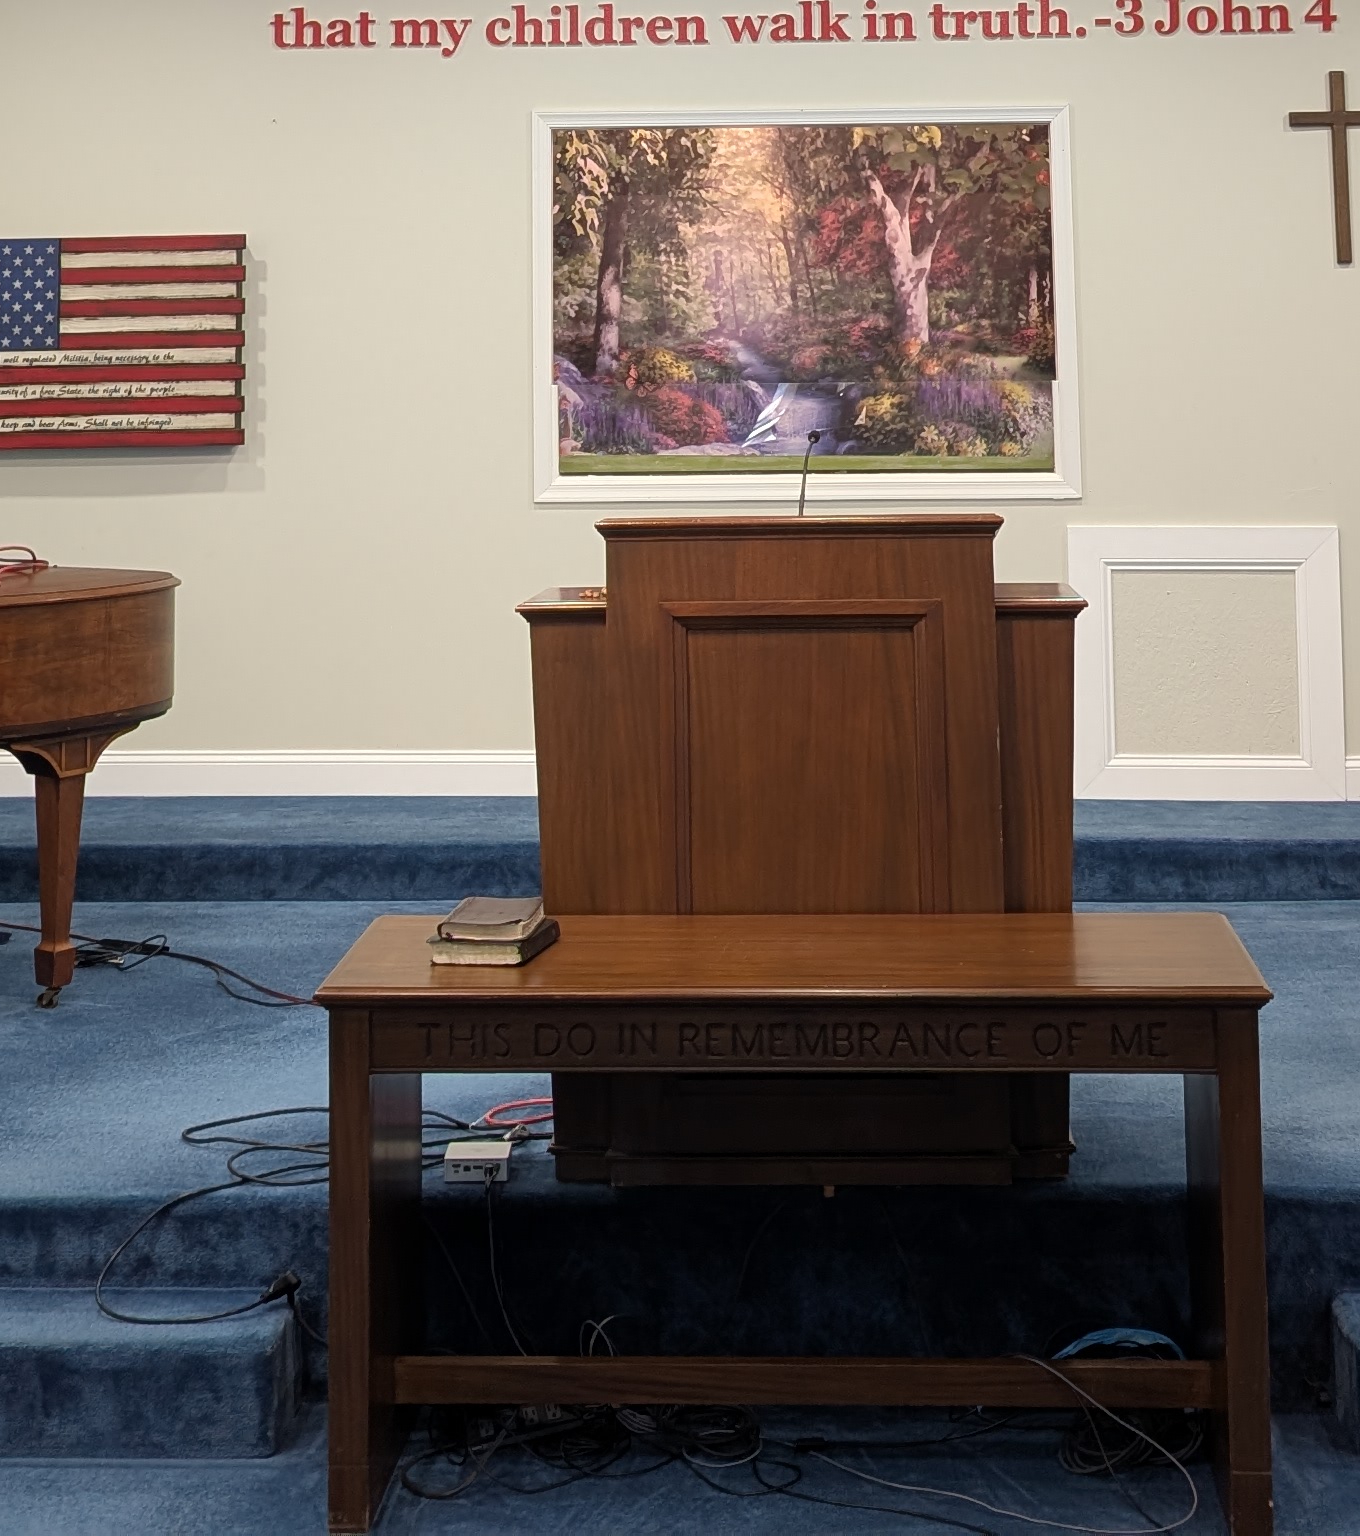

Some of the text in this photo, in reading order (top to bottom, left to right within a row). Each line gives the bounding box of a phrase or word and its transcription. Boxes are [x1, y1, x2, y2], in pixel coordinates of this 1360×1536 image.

[270, 7, 376, 50] that
[390, 18, 472, 60] my
[485, 3, 710, 48] children
[863, 0, 916, 42] in
[418, 1021, 1170, 1060] THIS DO IN REMEMBRANCE OF ME
